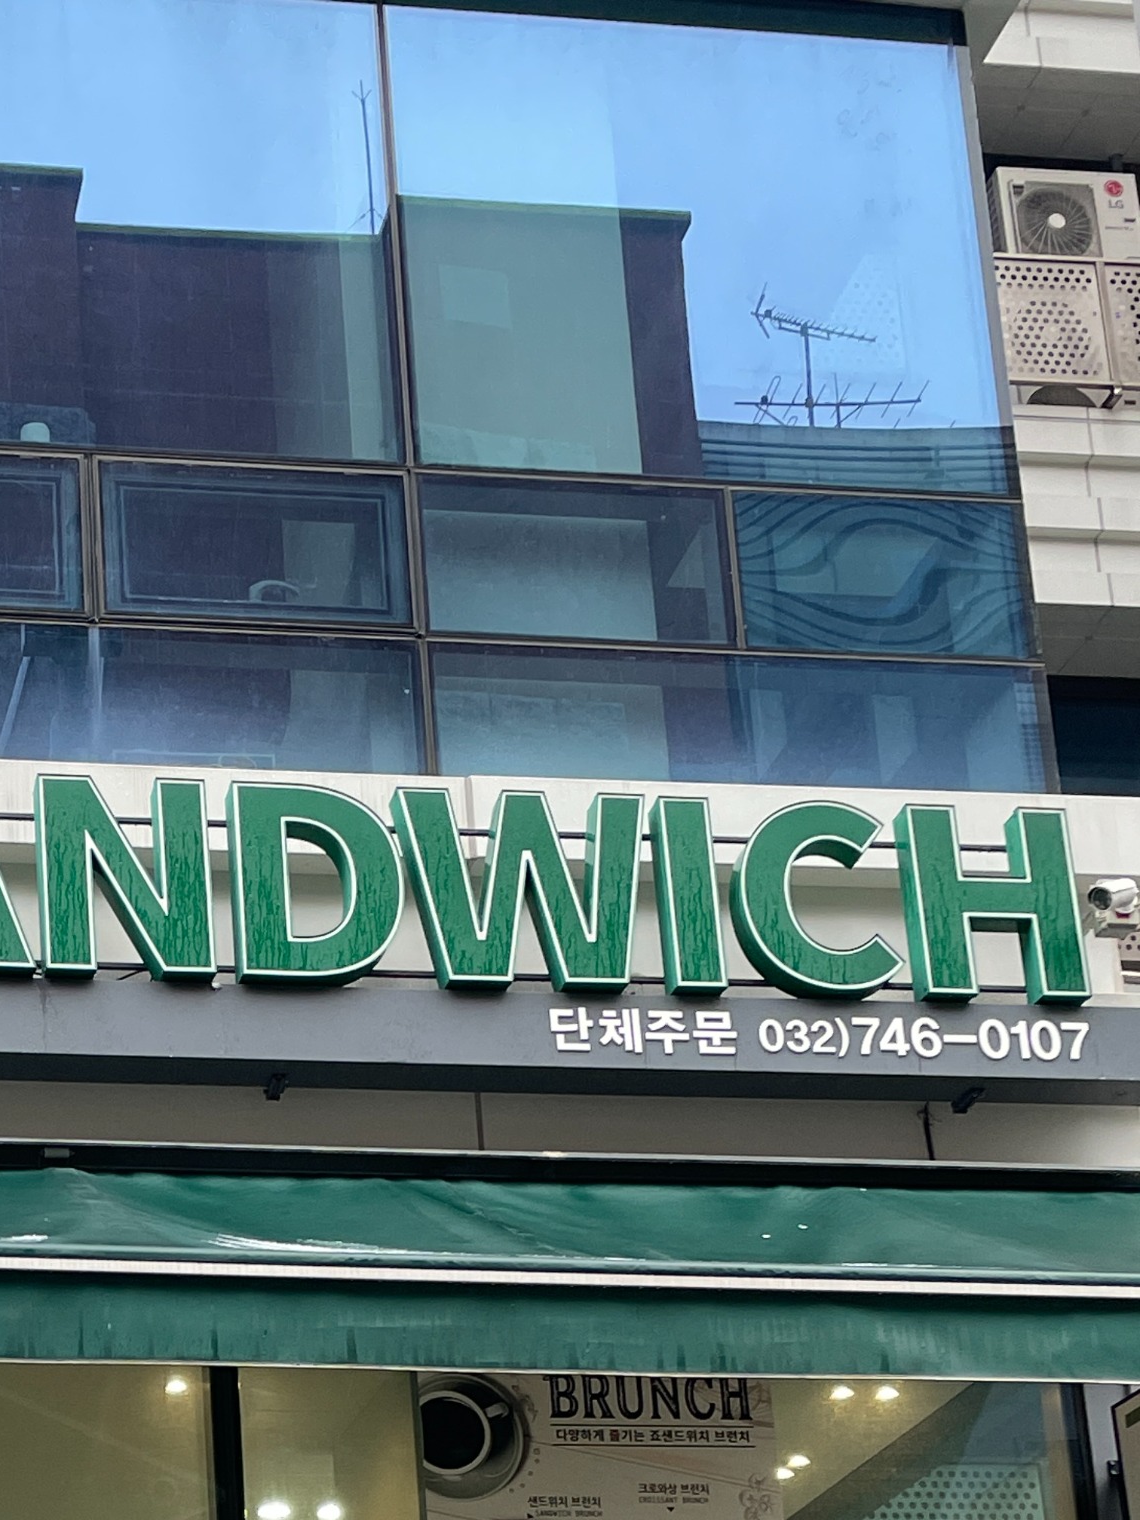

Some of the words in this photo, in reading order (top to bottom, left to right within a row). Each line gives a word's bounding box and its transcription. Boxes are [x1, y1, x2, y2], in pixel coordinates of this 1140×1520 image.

[1107, 198, 1125, 210] LG
[548, 1006, 739, 1056] 단체주문
[758, 1015, 1090, 1063] 032)746-0107
[542, 1374, 754, 1422] BRUNCH
[555, 1428, 605, 1443] 다양하게
[609, 1428, 645, 1443] 즐기는
[714, 1429, 751, 1444] 브런치
[526, 1495, 569, 1509] 샌드위치
[571, 1496, 602, 1509] 브런치
